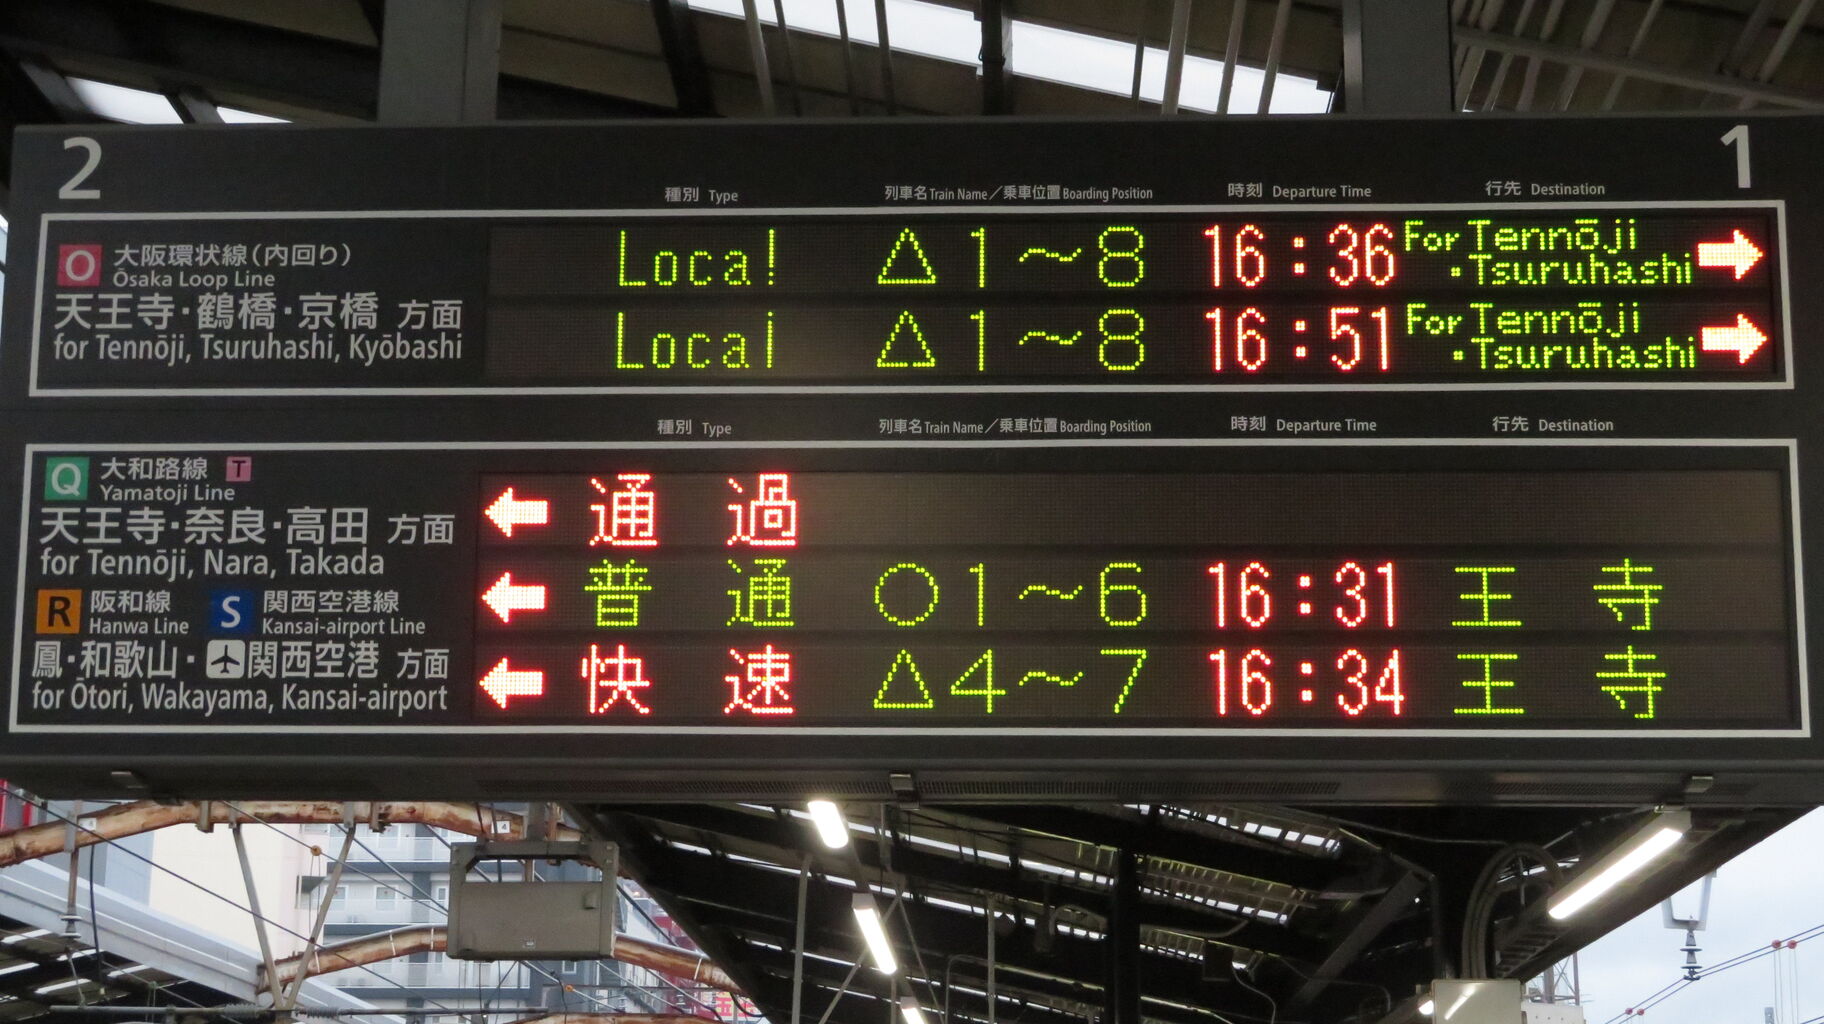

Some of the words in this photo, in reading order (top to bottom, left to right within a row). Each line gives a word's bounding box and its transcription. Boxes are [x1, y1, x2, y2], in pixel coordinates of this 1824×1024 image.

[59, 137, 101, 199] 2
[1721, 125, 1751, 188] 1
[665, 187, 699, 201] 種別
[709, 190, 738, 204] Type
[885, 186, 927, 200] 列車名
[930, 188, 954, 200] Train
[1004, 185, 1060, 199] 乗車位置
[1063, 187, 1108, 202] Boarding
[1112, 187, 1152, 199] Position
[1228, 183, 1262, 197] 時刻
[1273, 186, 1336, 200] Departure
[1340, 185, 1371, 197] Time
[1486, 181, 1521, 195] 行先
[1532, 183, 1605, 195] Destination
[1405, 221, 1459, 251] For
[1468, 219, 1635, 254] Tennōji
[66, 250, 95, 281] O
[113, 269, 172, 287] Ōsaka
[180, 272, 227, 290] Loop
[235, 271, 275, 286] Line
[55, 292, 378, 329] 天王寺・鶴橋・京橋
[398, 300, 462, 329] 方面
[1407, 303, 1462, 334] For
[1470, 302, 1638, 339] Tennōji
[54, 333, 88, 359] for
[96, 334, 191, 366] Tennōji,
[201, 332, 339, 363] Tsuruhashi,
[350, 332, 461, 366] Kyōbashi
[658, 419, 691, 434] 種別
[702, 423, 731, 437] Type
[880, 419, 921, 434] 列車名
[925, 422, 949, 433] Train
[1000, 418, 1057, 432] 乗車位置
[1060, 420, 1106, 435] Boarding
[1110, 420, 1151, 432] Position
[1231, 416, 1265, 431] 時刻
[1277, 419, 1341, 434] Departure
[1345, 419, 1376, 431] Time
[1493, 416, 1528, 431] 行先
[1539, 419, 1613, 431] Destination
[52, 463, 81, 496] Q
[101, 457, 207, 480] 大和路線
[232, 460, 246, 477] T
[100, 484, 187, 505] Yamatoji
[195, 484, 235, 500] Line
[589, 472, 798, 548] 通過
[40, 506, 368, 544] 天王寺・奈良・高田
[388, 514, 455, 544] 方面
[41, 547, 78, 575] for
[88, 549, 193, 582] Tennōji,
[205, 549, 276, 578] Nara,
[287, 547, 384, 574] Takada
[91, 590, 170, 613] 阪和線
[264, 590, 398, 613] 関西空港線
[585, 559, 794, 626] 普通
[1452, 559, 1662, 630] 王寺
[48, 596, 70, 626] R
[90, 618, 148, 634] Hanwa
[155, 618, 188, 634] Line
[221, 596, 240, 628] S
[263, 618, 385, 638] Kansai-airport
[391, 618, 425, 634] Line
[248, 640, 378, 678] 関西空港
[397, 648, 449, 679] 方面
[579, 643, 796, 716] 快速
[1454, 646, 1666, 718] 王寺
[33, 682, 64, 709] for
[71, 675, 133, 713] Ōtori,
[142, 682, 273, 717] Wakayama,
[283, 683, 447, 717] Kansai-airport
